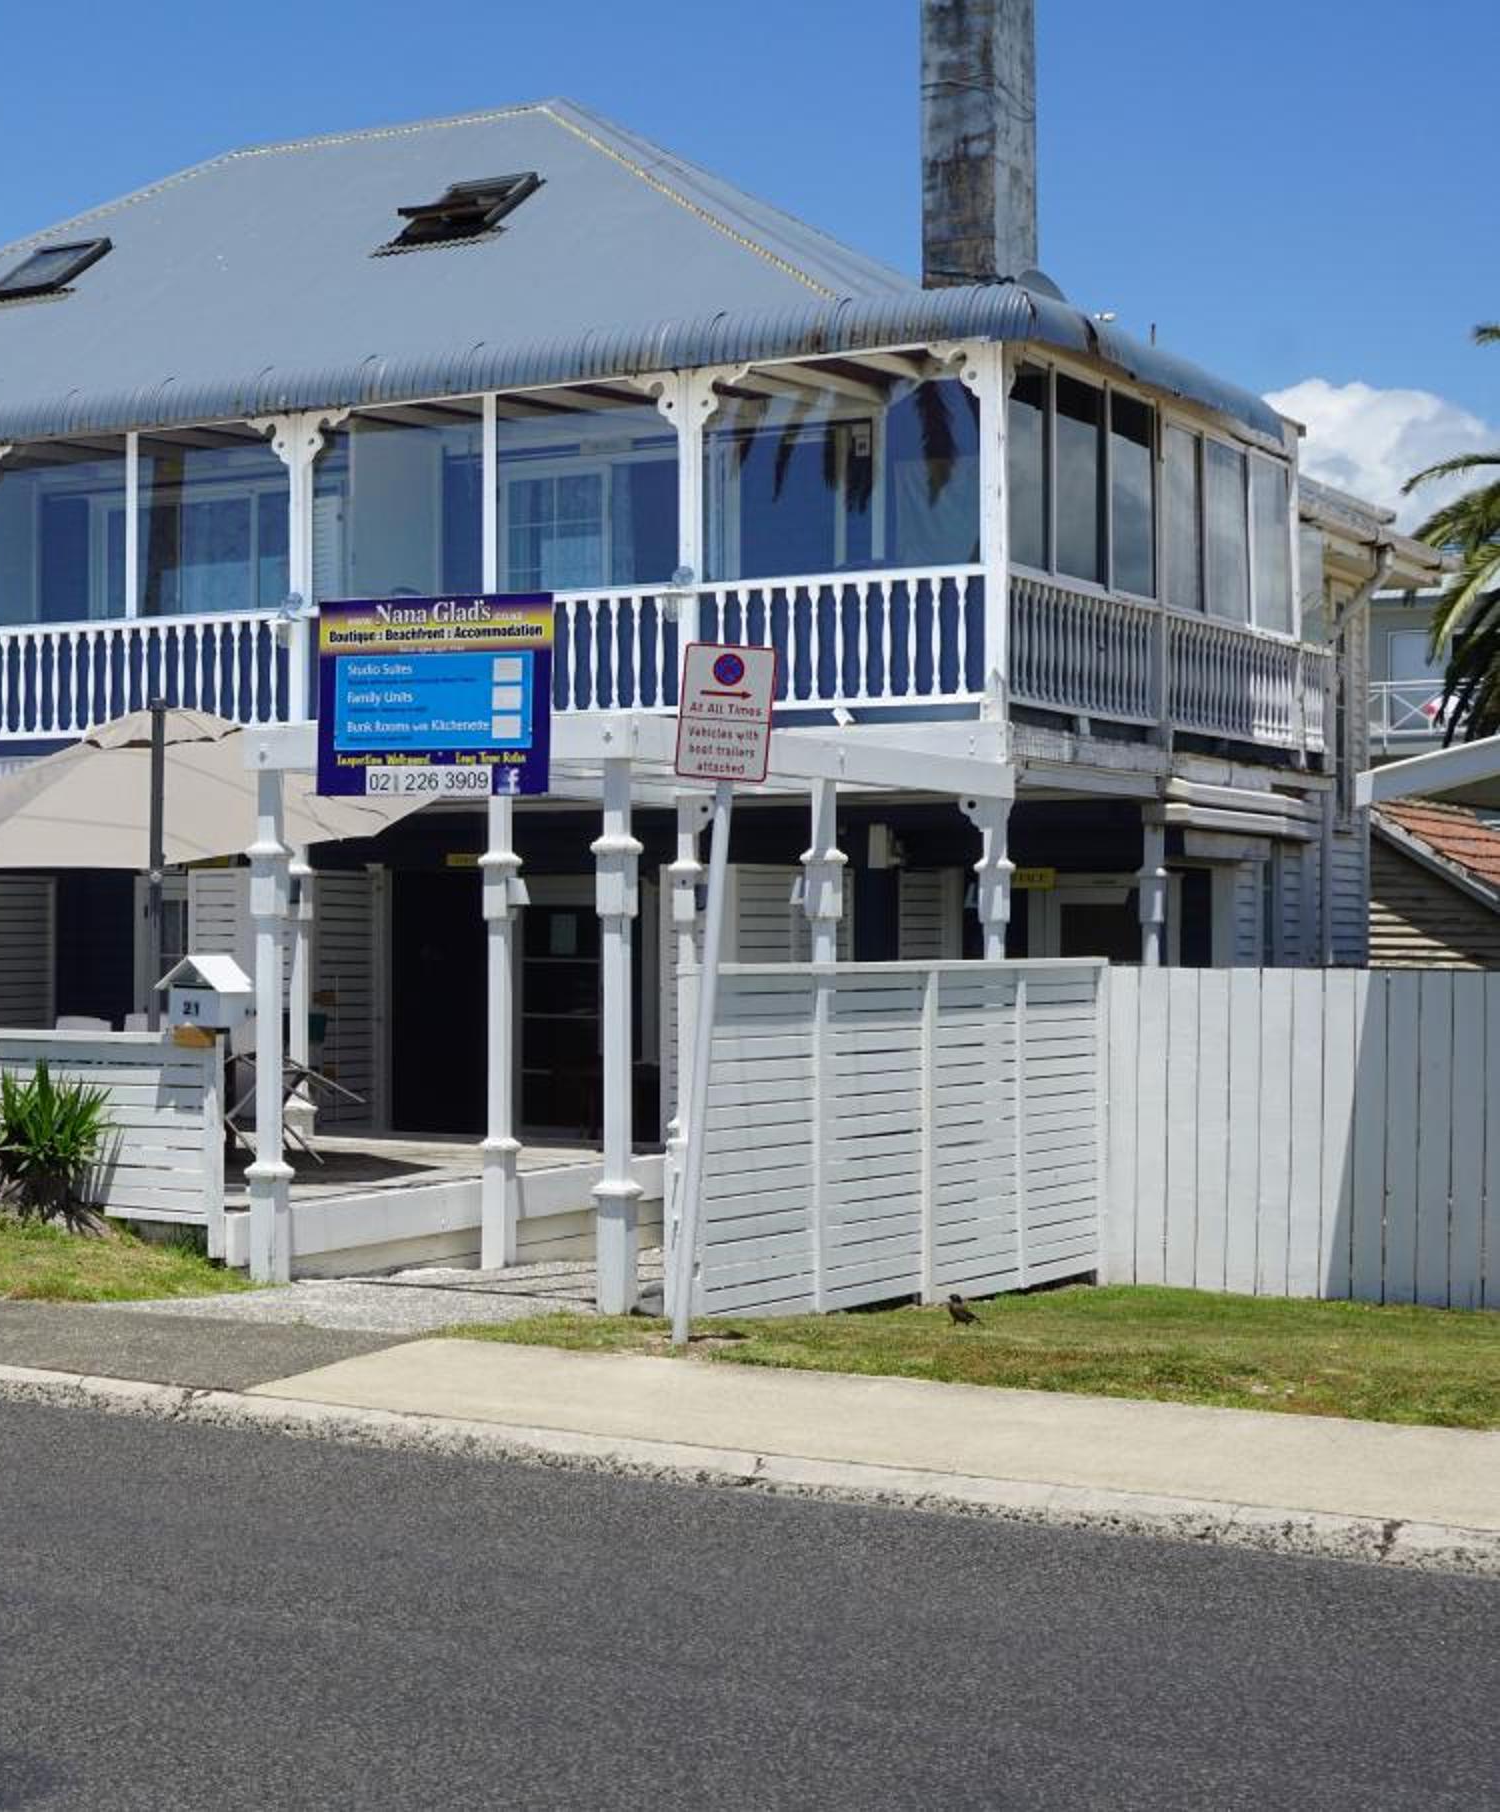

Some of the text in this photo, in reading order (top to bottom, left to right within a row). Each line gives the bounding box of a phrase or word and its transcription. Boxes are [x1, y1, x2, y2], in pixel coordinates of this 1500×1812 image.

[375, 603, 427, 625] Nana
[433, 600, 491, 623] Glad's
[329, 630, 376, 645] Boutique
[385, 627, 445, 641] Beachfront
[454, 624, 543, 638] Accommodation
[347, 661, 413, 676] Studio Suites
[347, 690, 413, 706] Family Units
[689, 702, 762, 717] At All Times
[347, 720, 373, 733] Bunk
[375, 719, 410, 732] Rooms
[688, 725, 759, 741] Vehicles with
[688, 743, 755, 759] boat trailers
[697, 762, 745, 775] attached
[405, 771, 439, 791] 226
[445, 770, 489, 790] 3909
[182, 1000, 200, 1017] 21
